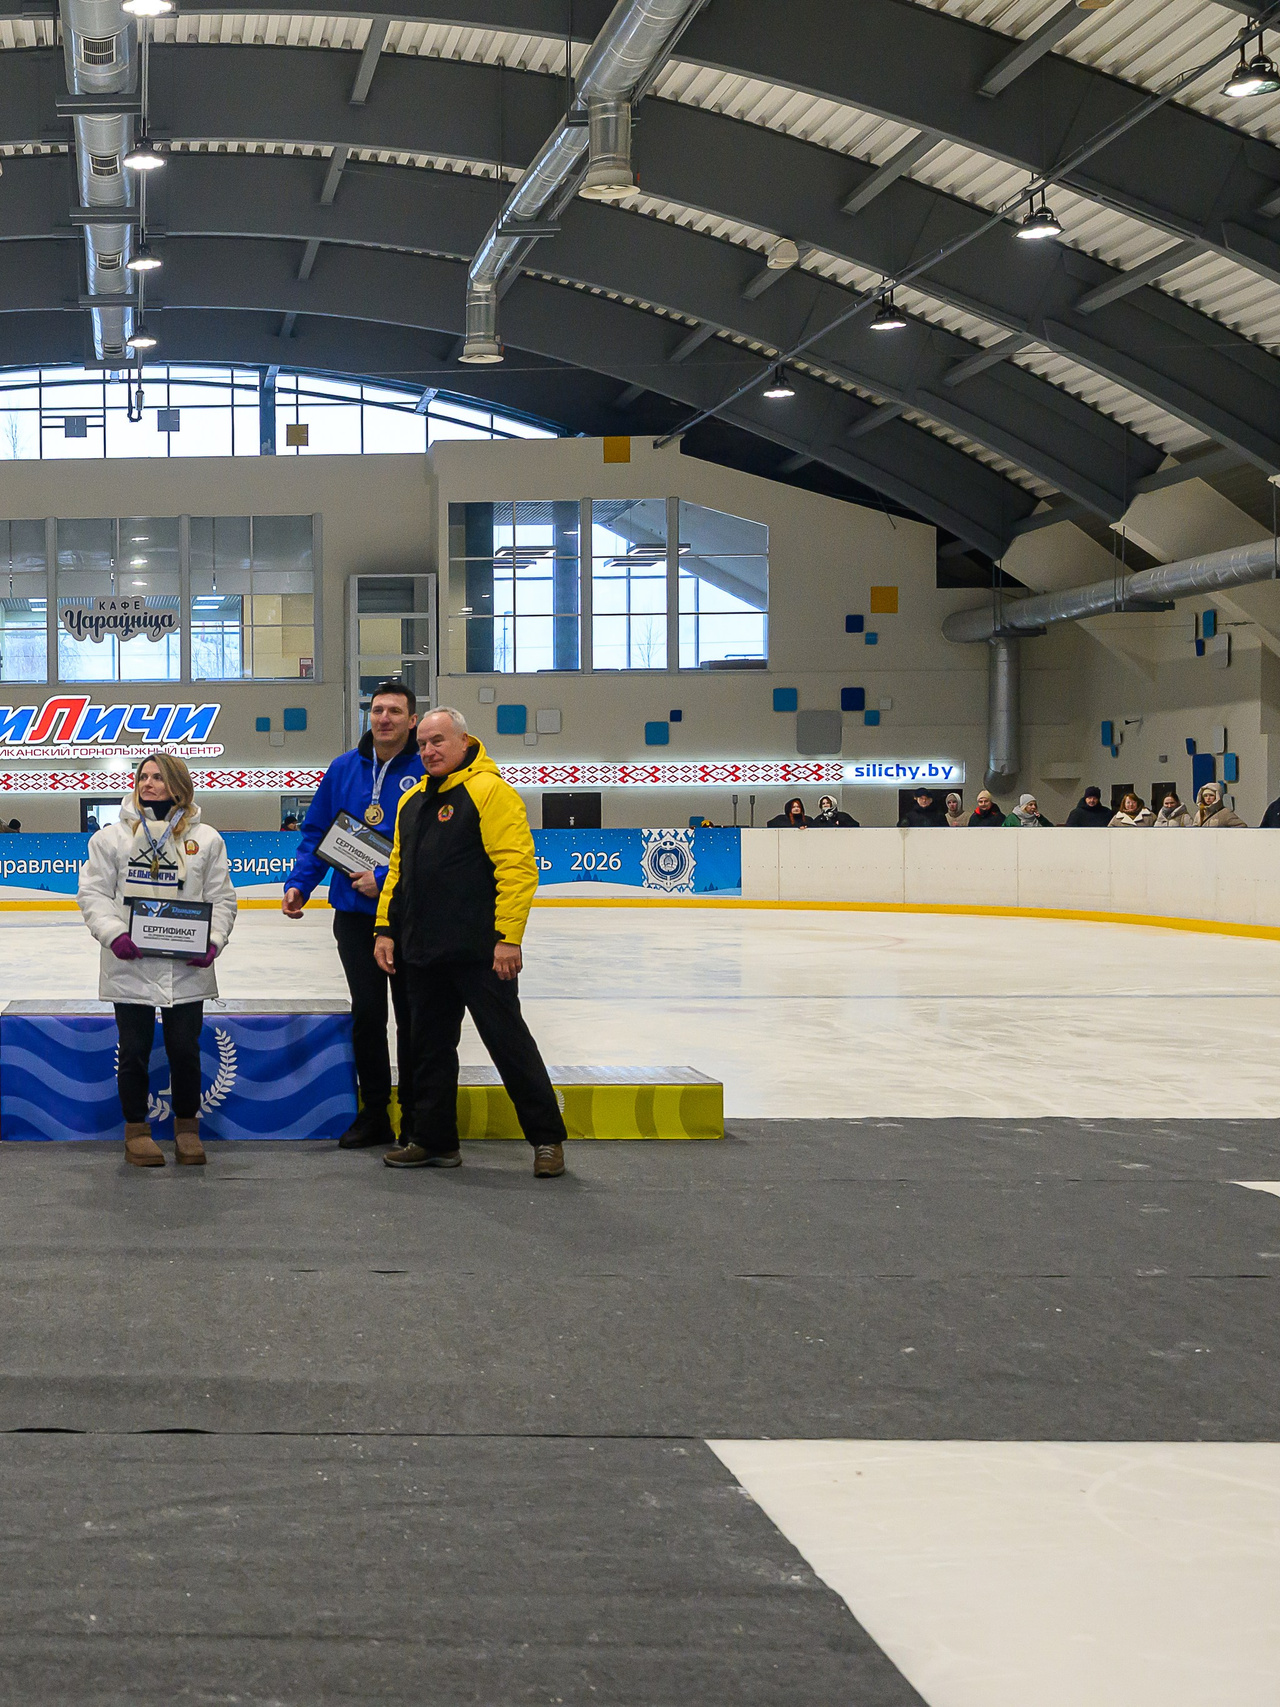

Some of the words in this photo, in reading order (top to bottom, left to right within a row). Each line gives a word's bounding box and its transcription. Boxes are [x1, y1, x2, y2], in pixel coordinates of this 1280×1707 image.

[99, 601, 141, 611] КАФЕ
[64, 609, 176, 638] Чараўніца
[180, 746, 222, 756] ЦЕНТР
[854, 763, 954, 780] silichy.by
[570, 852, 622, 871] 2026
[142, 925, 197, 937] СЕРТИФИКАТ
